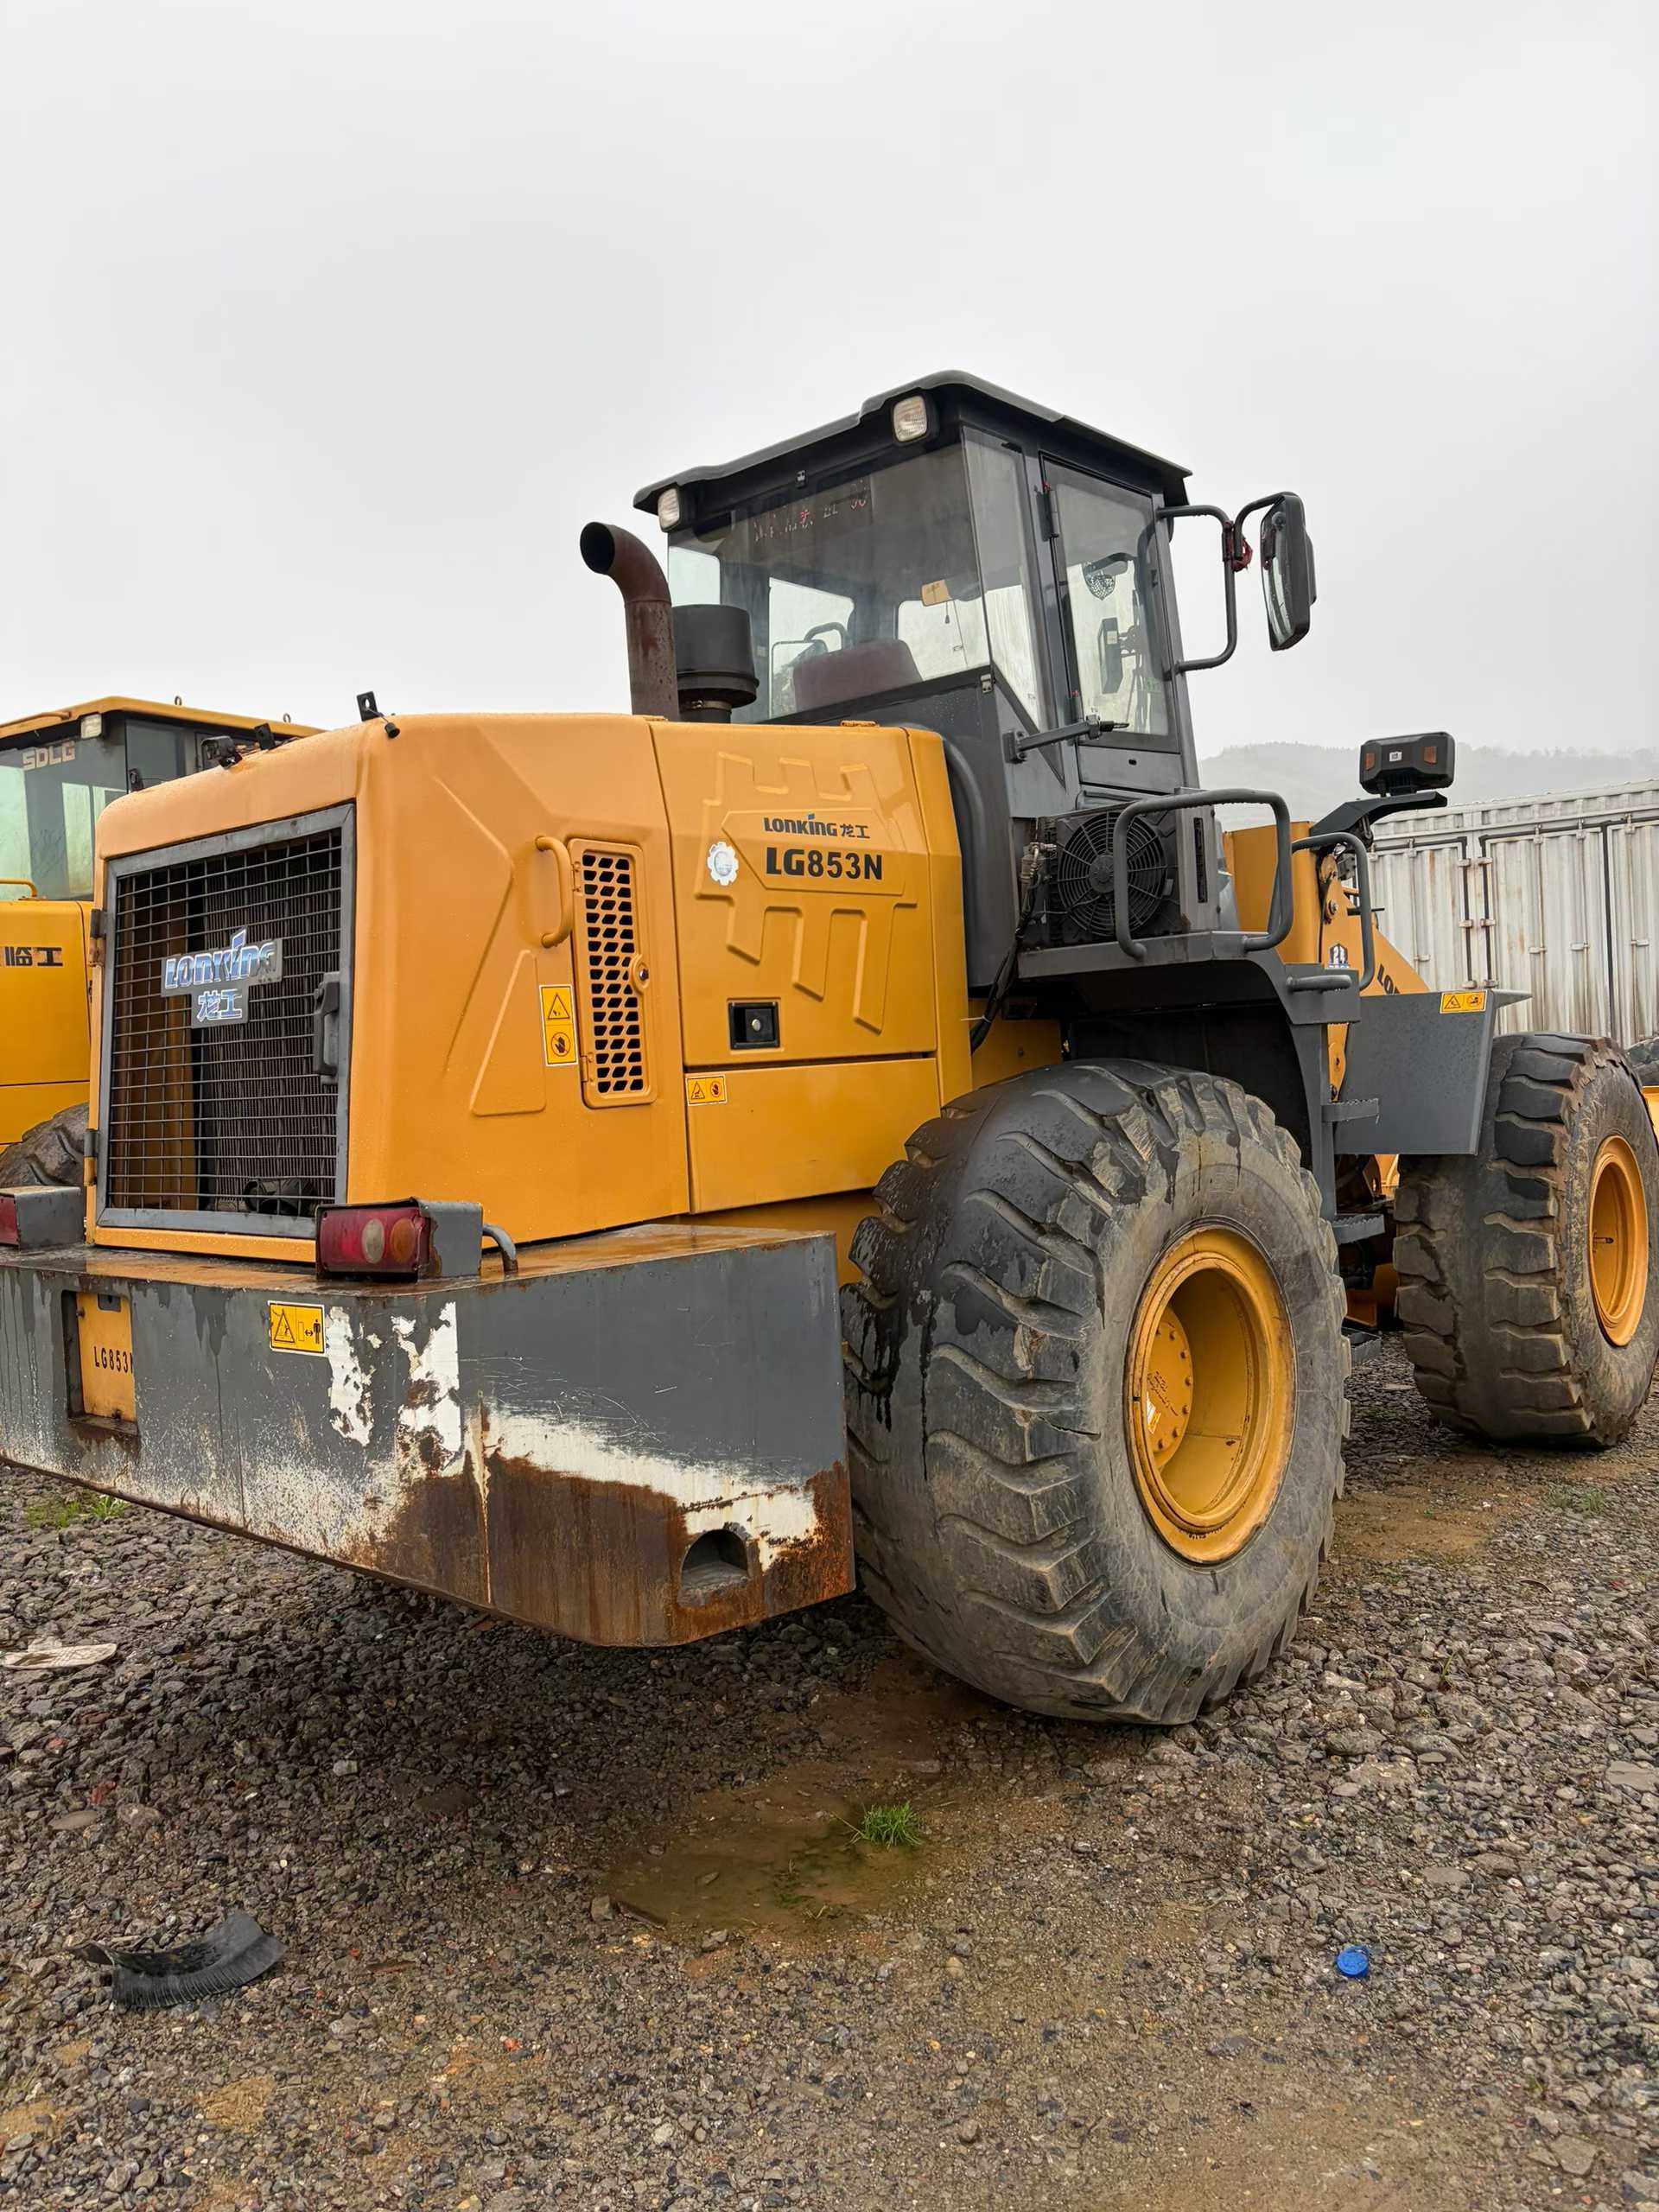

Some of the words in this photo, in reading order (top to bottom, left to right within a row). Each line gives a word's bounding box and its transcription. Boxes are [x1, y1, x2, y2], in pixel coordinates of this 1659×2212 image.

[22, 741, 75, 771] SDLG
[840, 823, 870, 839] 龙工
[766, 847, 882, 880] LG853N
[197, 988, 242, 1022] 龙工
